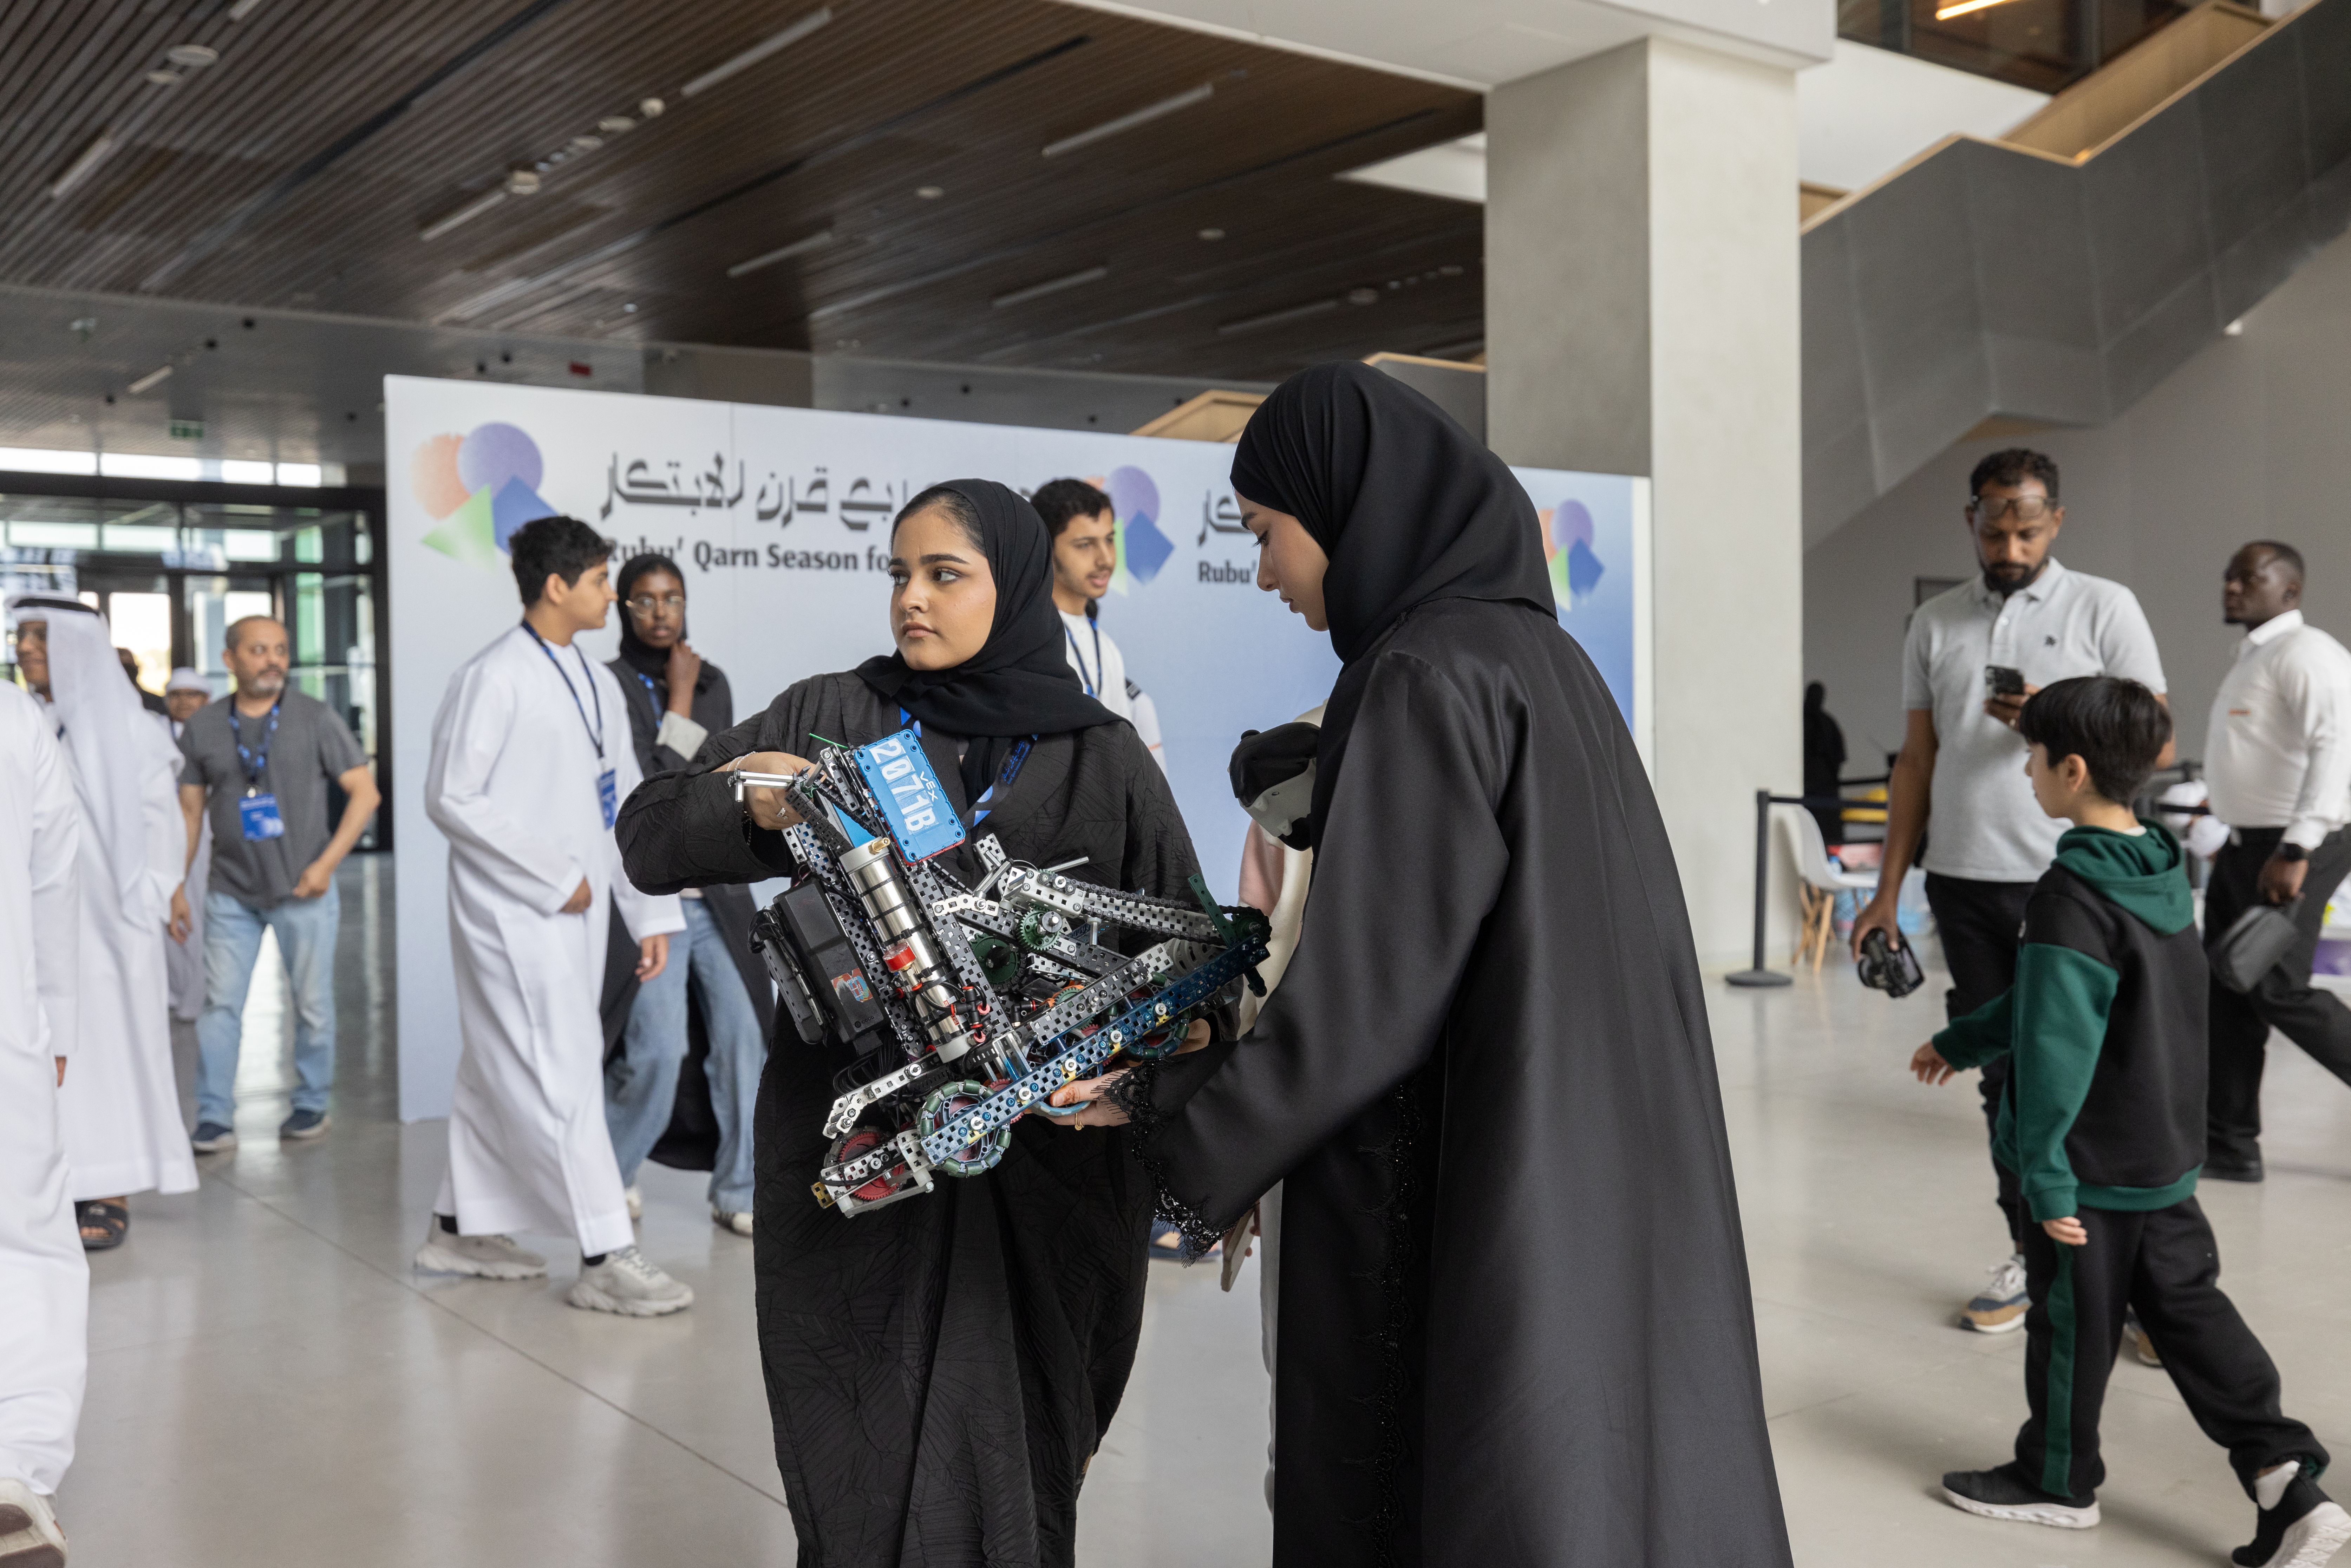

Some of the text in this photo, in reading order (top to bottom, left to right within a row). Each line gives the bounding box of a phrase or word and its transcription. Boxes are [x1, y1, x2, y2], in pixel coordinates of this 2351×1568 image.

[756, 466, 827, 528] قرن
[694, 540, 758, 571] Qarn
[766, 543, 858, 570] Season
[866, 545, 890, 571] fo
[1198, 560, 1257, 583] Rubu'
[869, 738, 936, 831] 2071B
[920, 770, 938, 802] VEX
